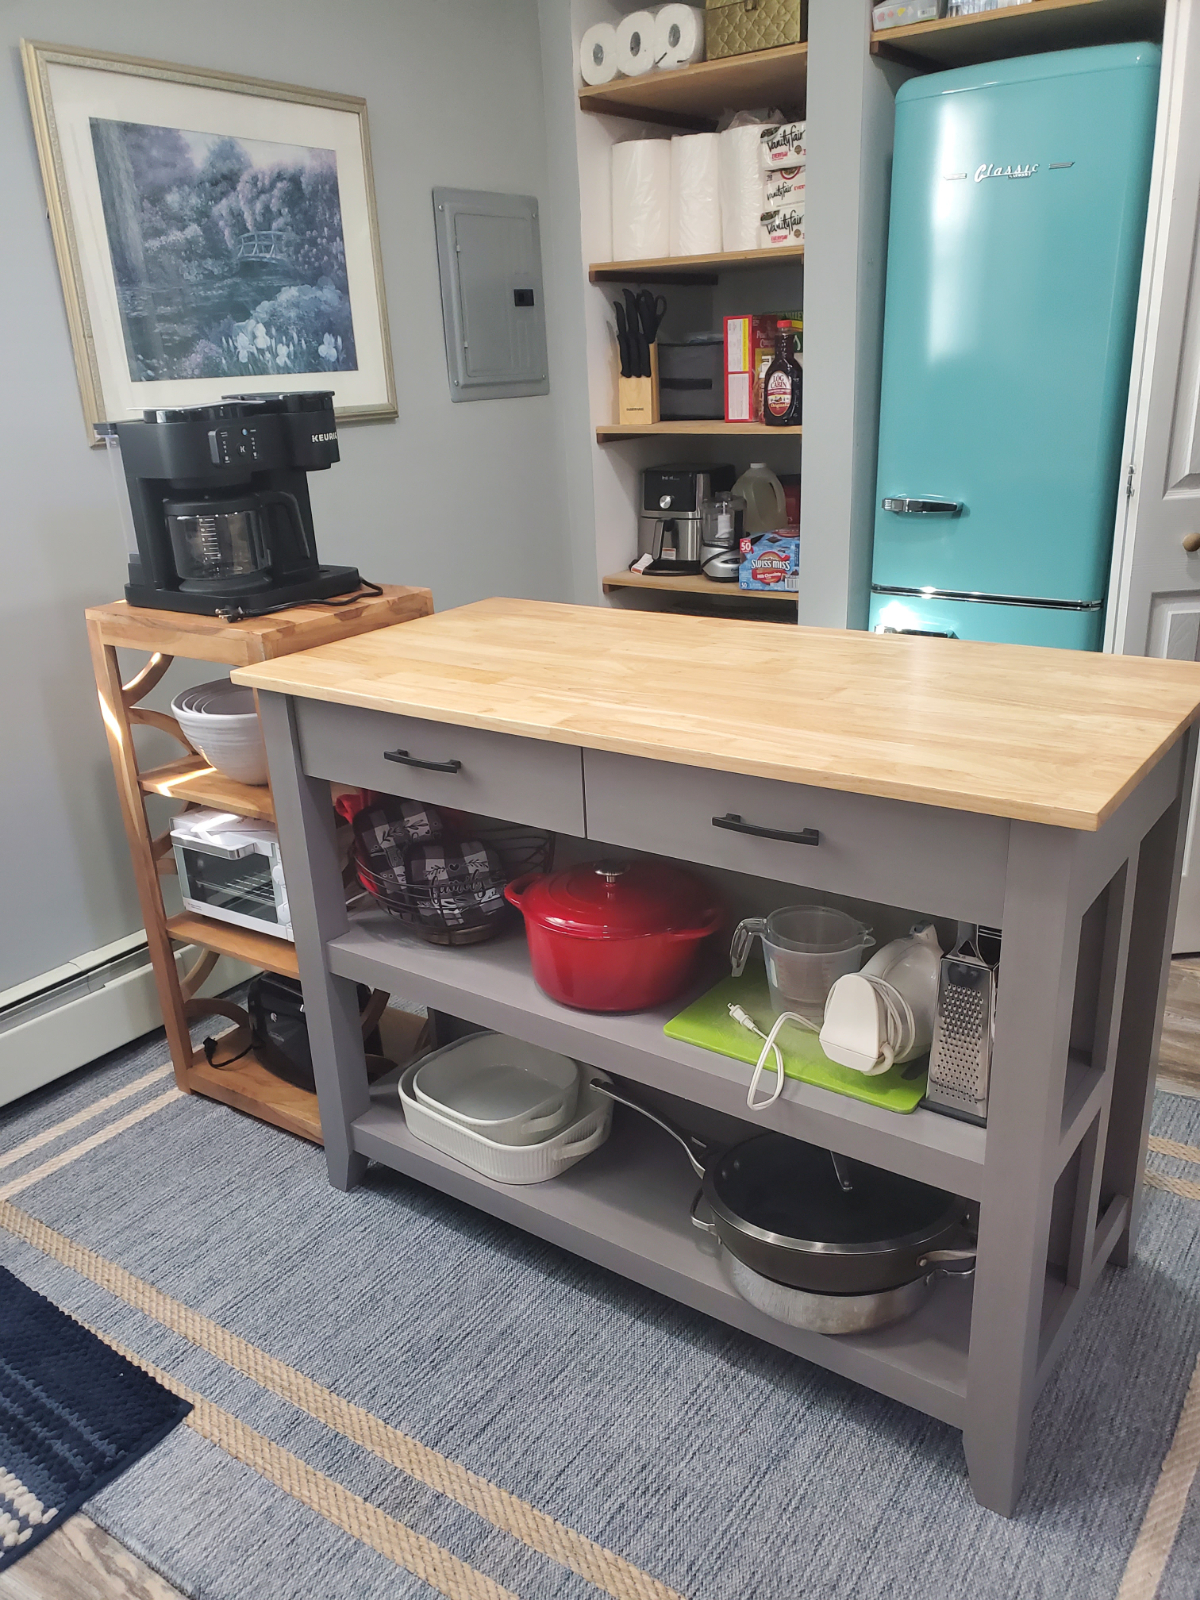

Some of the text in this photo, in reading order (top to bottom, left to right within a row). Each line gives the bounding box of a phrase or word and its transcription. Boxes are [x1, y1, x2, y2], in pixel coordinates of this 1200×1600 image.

[974, 163, 1039, 182] Classic
[773, 374, 784, 382] LOG
[741, 542, 751, 551] 50
[751, 559, 771, 569] SWISS
[430, 869, 486, 905] family
